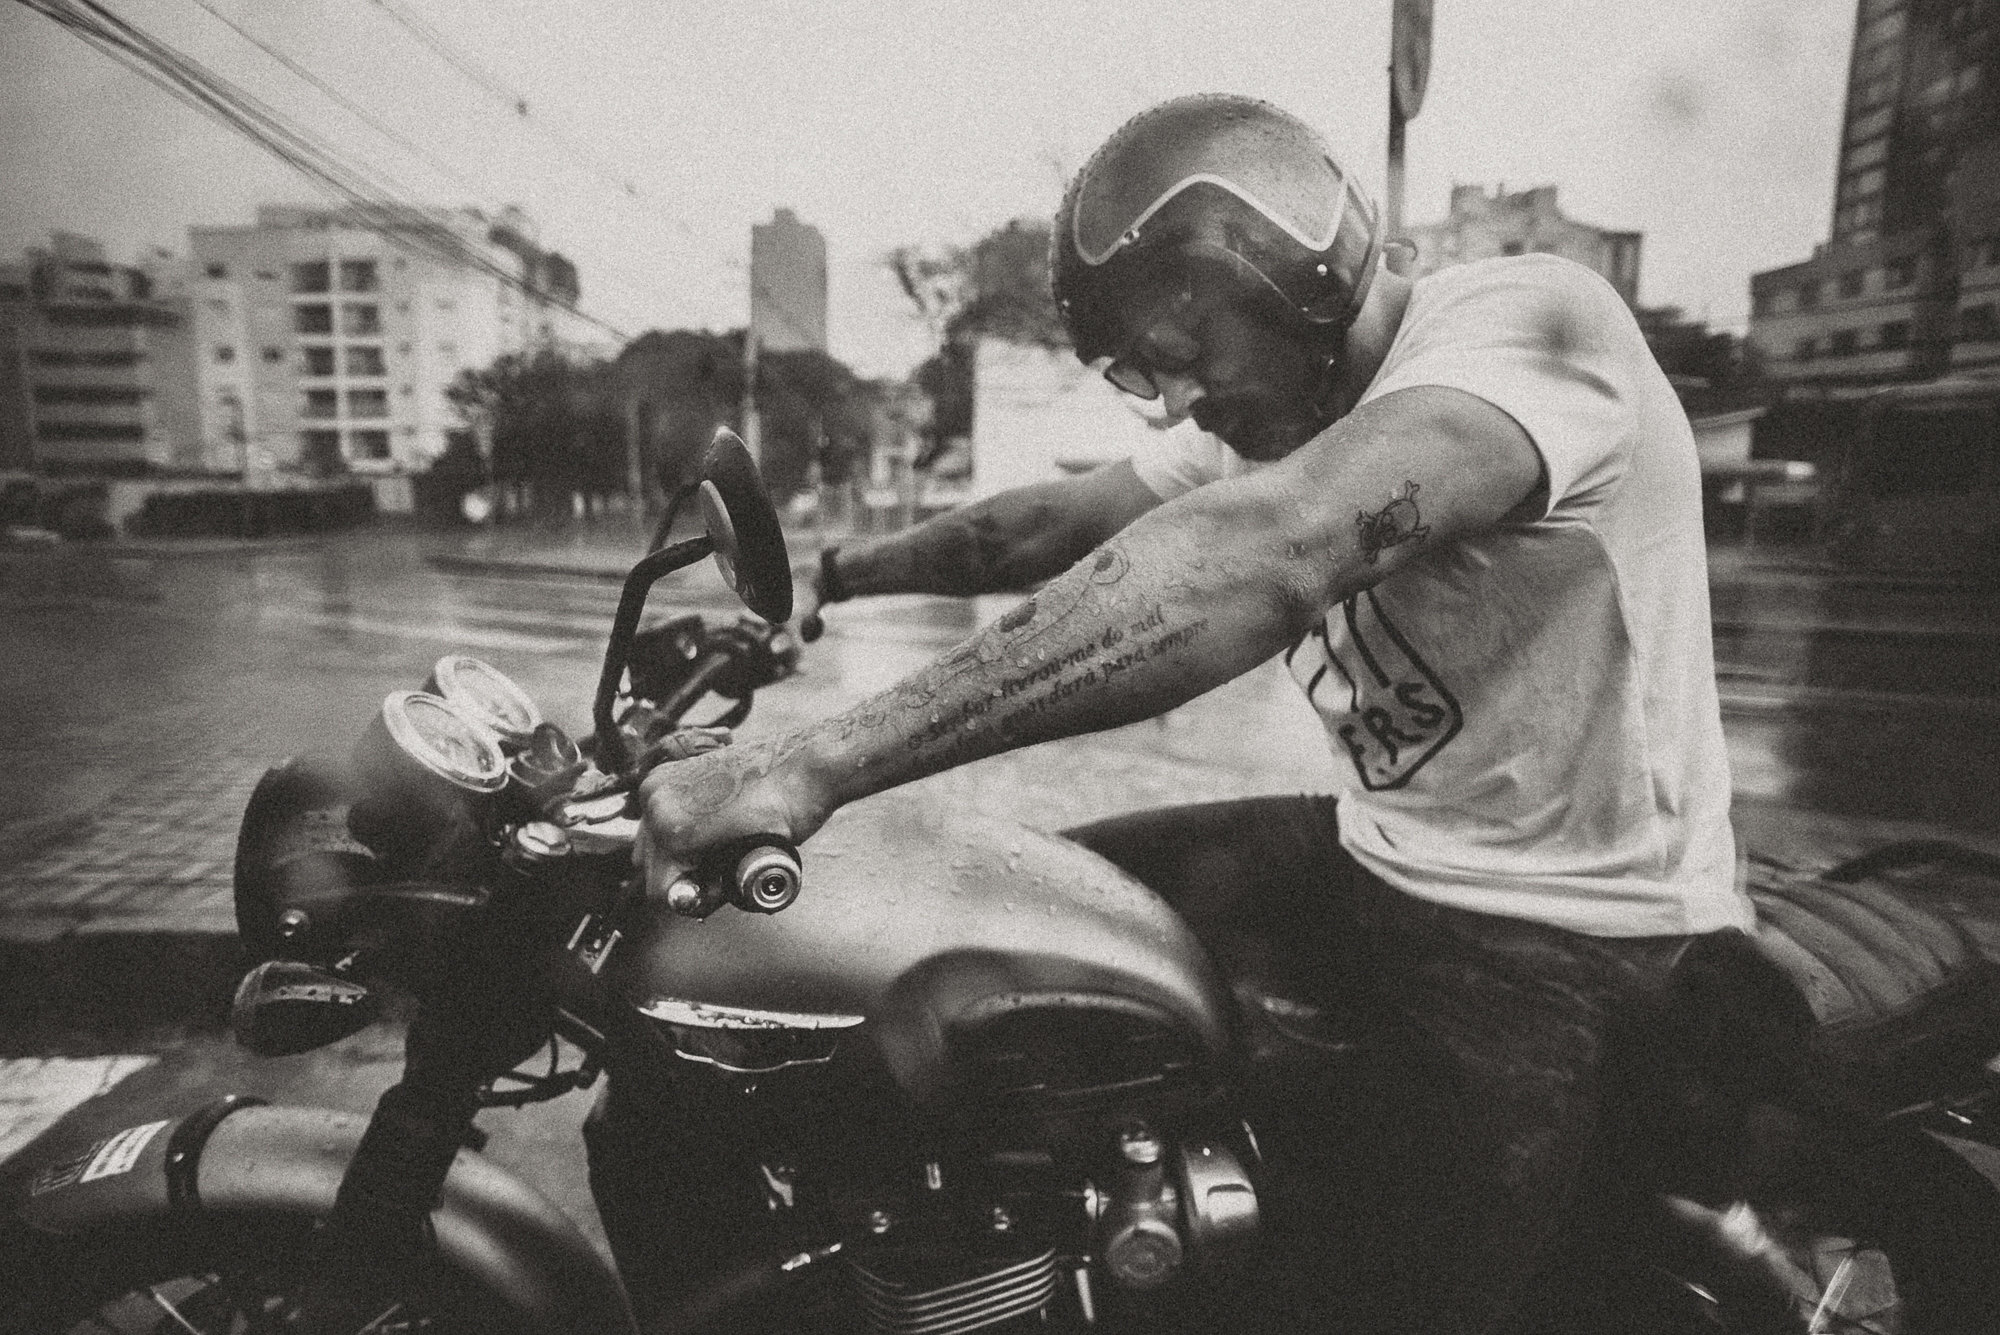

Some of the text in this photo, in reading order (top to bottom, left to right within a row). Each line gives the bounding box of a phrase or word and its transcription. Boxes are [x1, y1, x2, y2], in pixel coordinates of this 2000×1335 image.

[1101, 625, 1123, 648] do
[1128, 601, 1165, 636] mal
[1102, 646, 1147, 683] para
